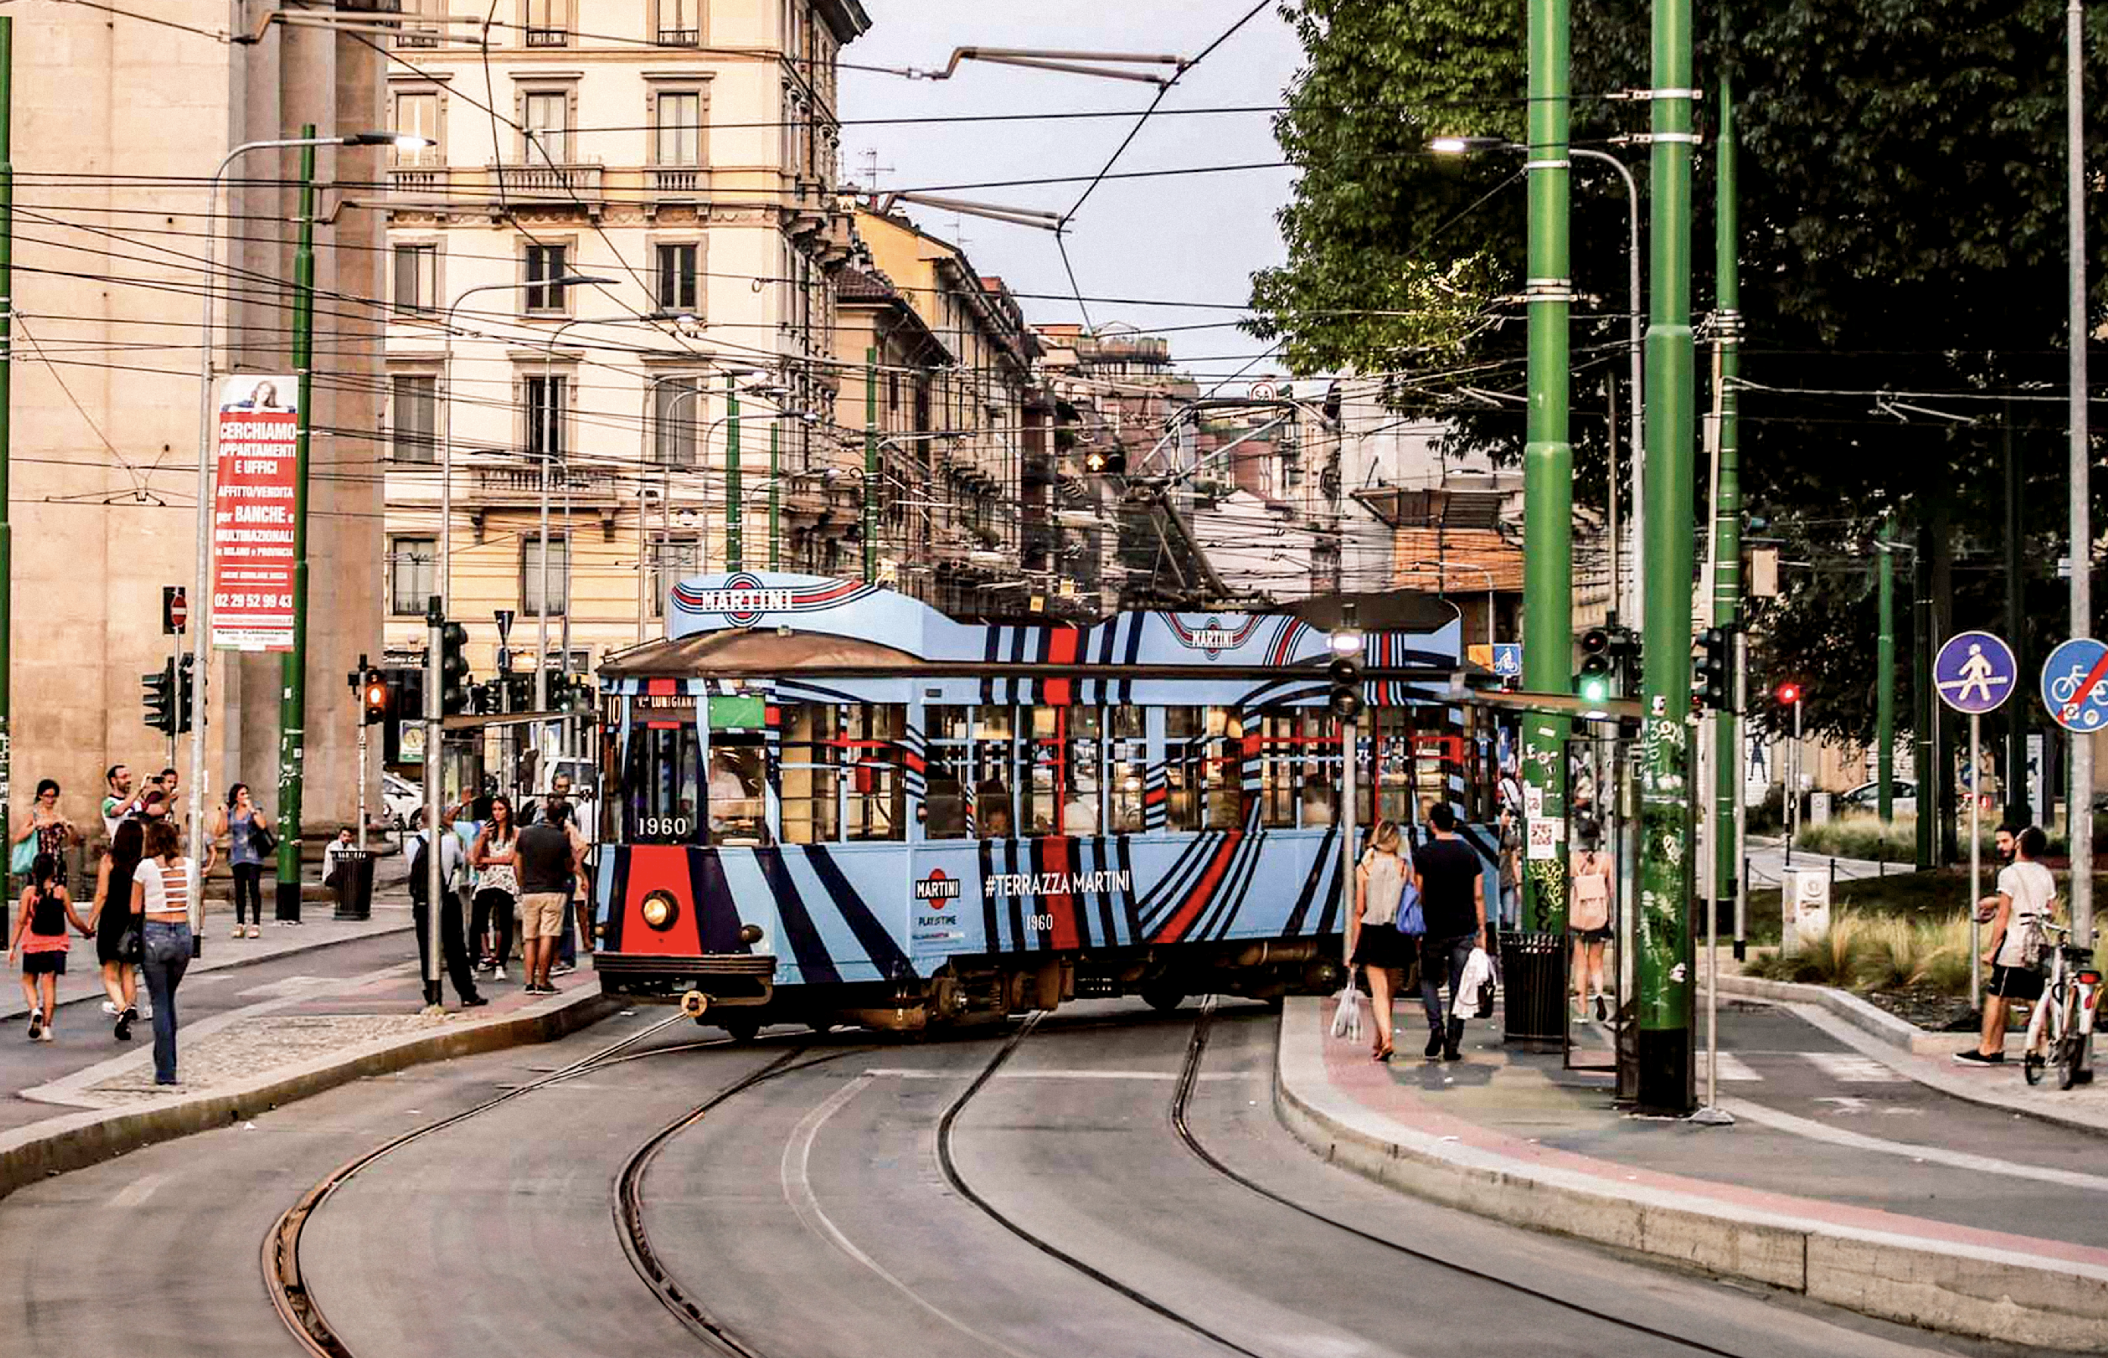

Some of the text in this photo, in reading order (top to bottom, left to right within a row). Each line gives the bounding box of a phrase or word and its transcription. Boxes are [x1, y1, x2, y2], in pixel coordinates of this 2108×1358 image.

[220, 422, 296, 440] CERCHIAMO
[219, 442, 296, 457] APPARTAMENTI
[235, 460, 277, 474] E UFFICI
[217, 485, 294, 498] AFFITTO/VENDITA
[217, 505, 295, 525] per BANCHE e
[214, 593, 229, 608] 02
[230, 593, 245, 608] 29
[246, 593, 261, 608] 52
[279, 593, 293, 608] 43
[702, 590, 792, 611] MARTINI
[1192, 630, 1233, 648] MARTINI
[608, 696, 621, 724] 10
[639, 817, 687, 835] 1960
[917, 880, 959, 898] MARTINI
[985, 870, 1130, 897] #TERRAZZA MARTINI
[1026, 914, 1053, 930] 1960
